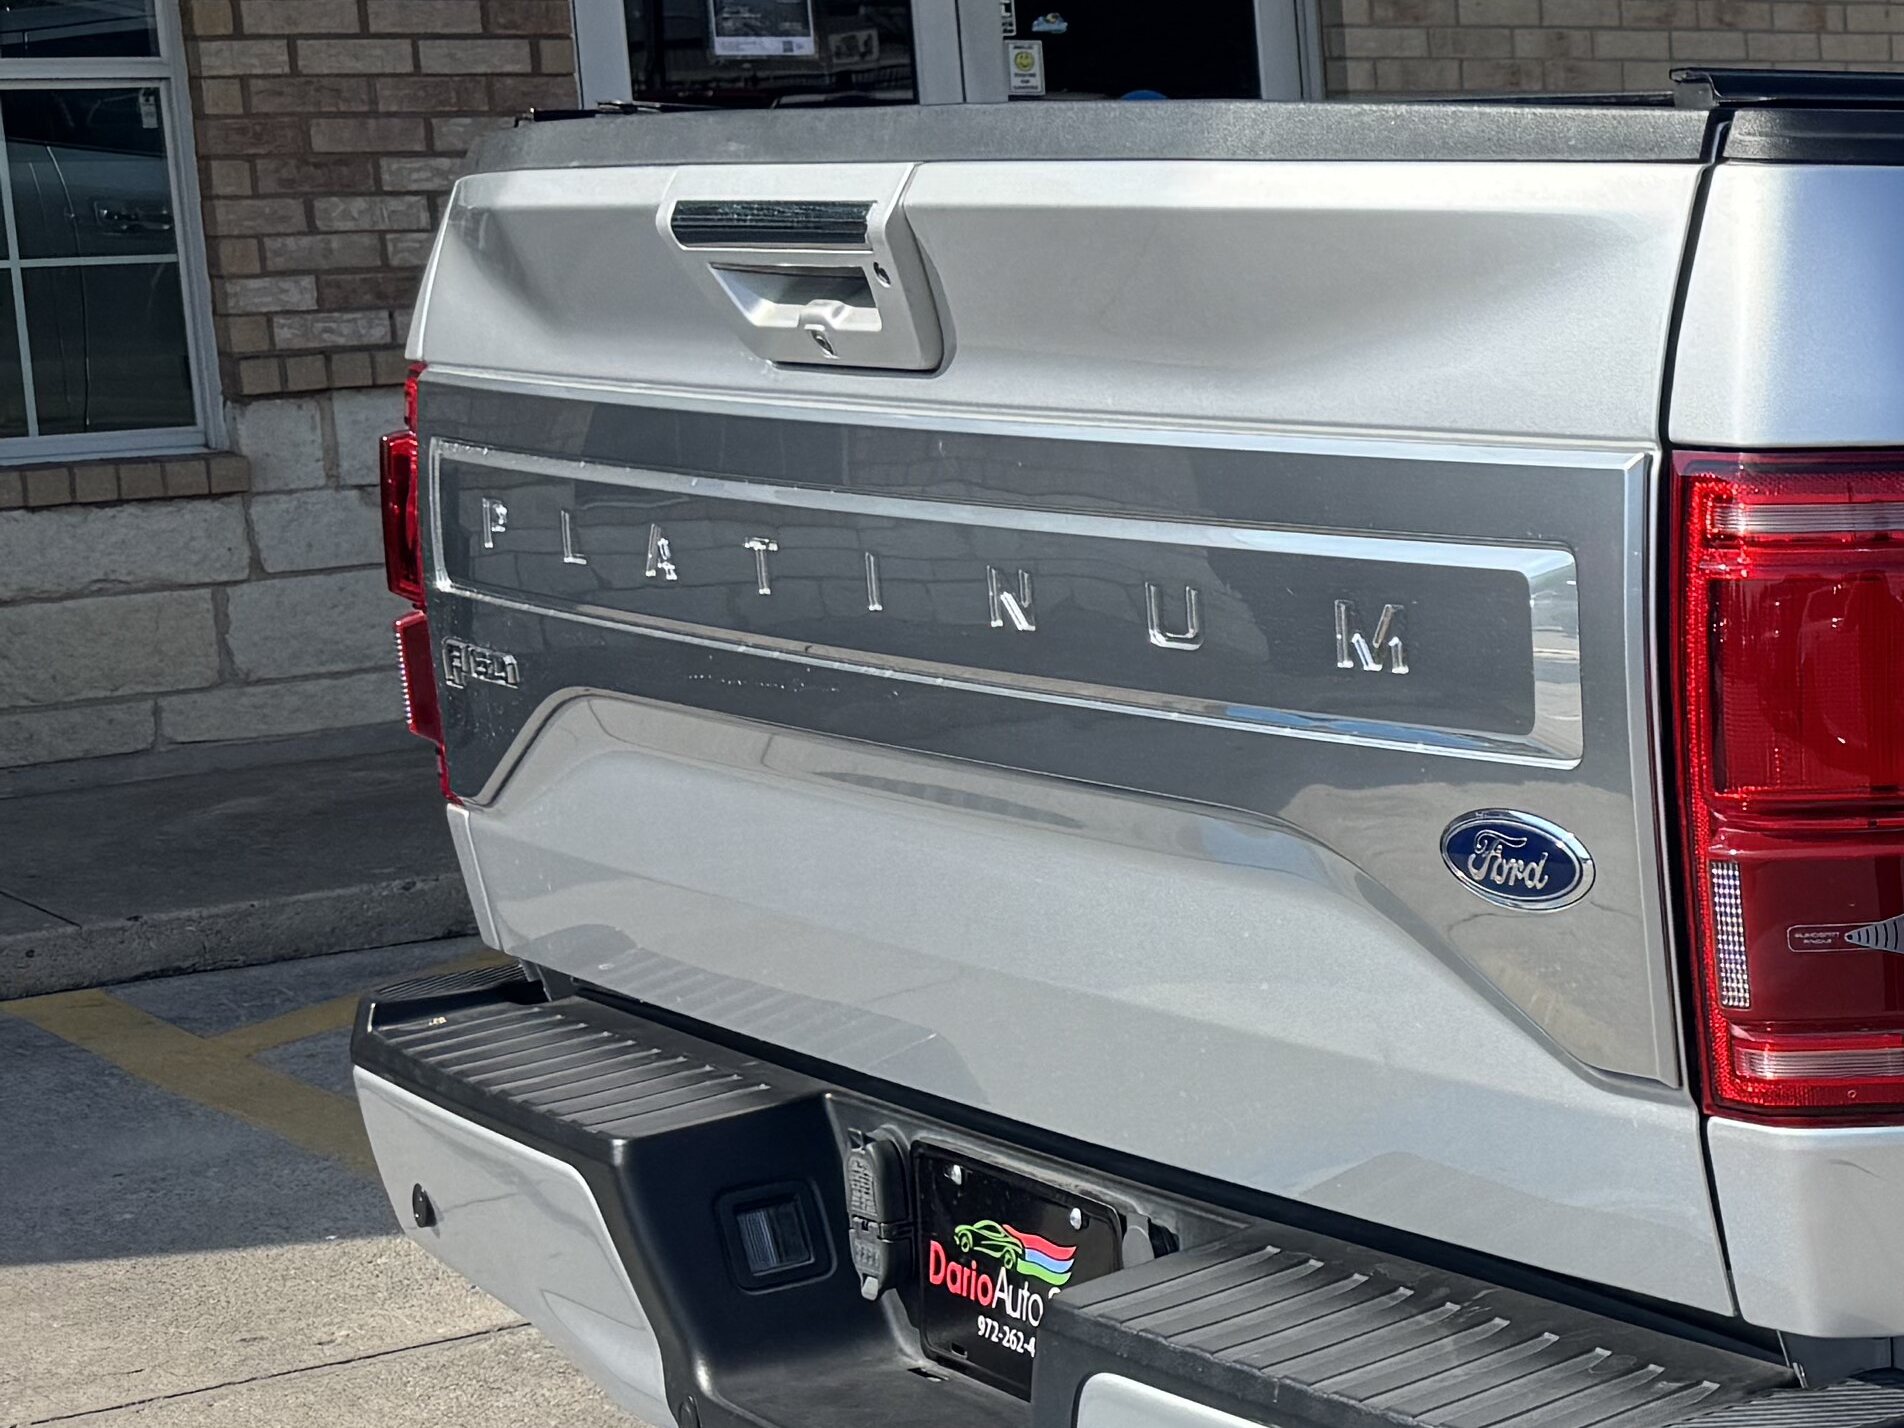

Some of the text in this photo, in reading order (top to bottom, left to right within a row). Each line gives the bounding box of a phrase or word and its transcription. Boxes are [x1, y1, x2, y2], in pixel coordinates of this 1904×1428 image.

[481, 497, 1409, 676] PLATINUM
[1467, 829, 1549, 890] Ford
[929, 1240, 1044, 1327] Dario Auto
[977, 1315, 1036, 1358] 972-262-4
